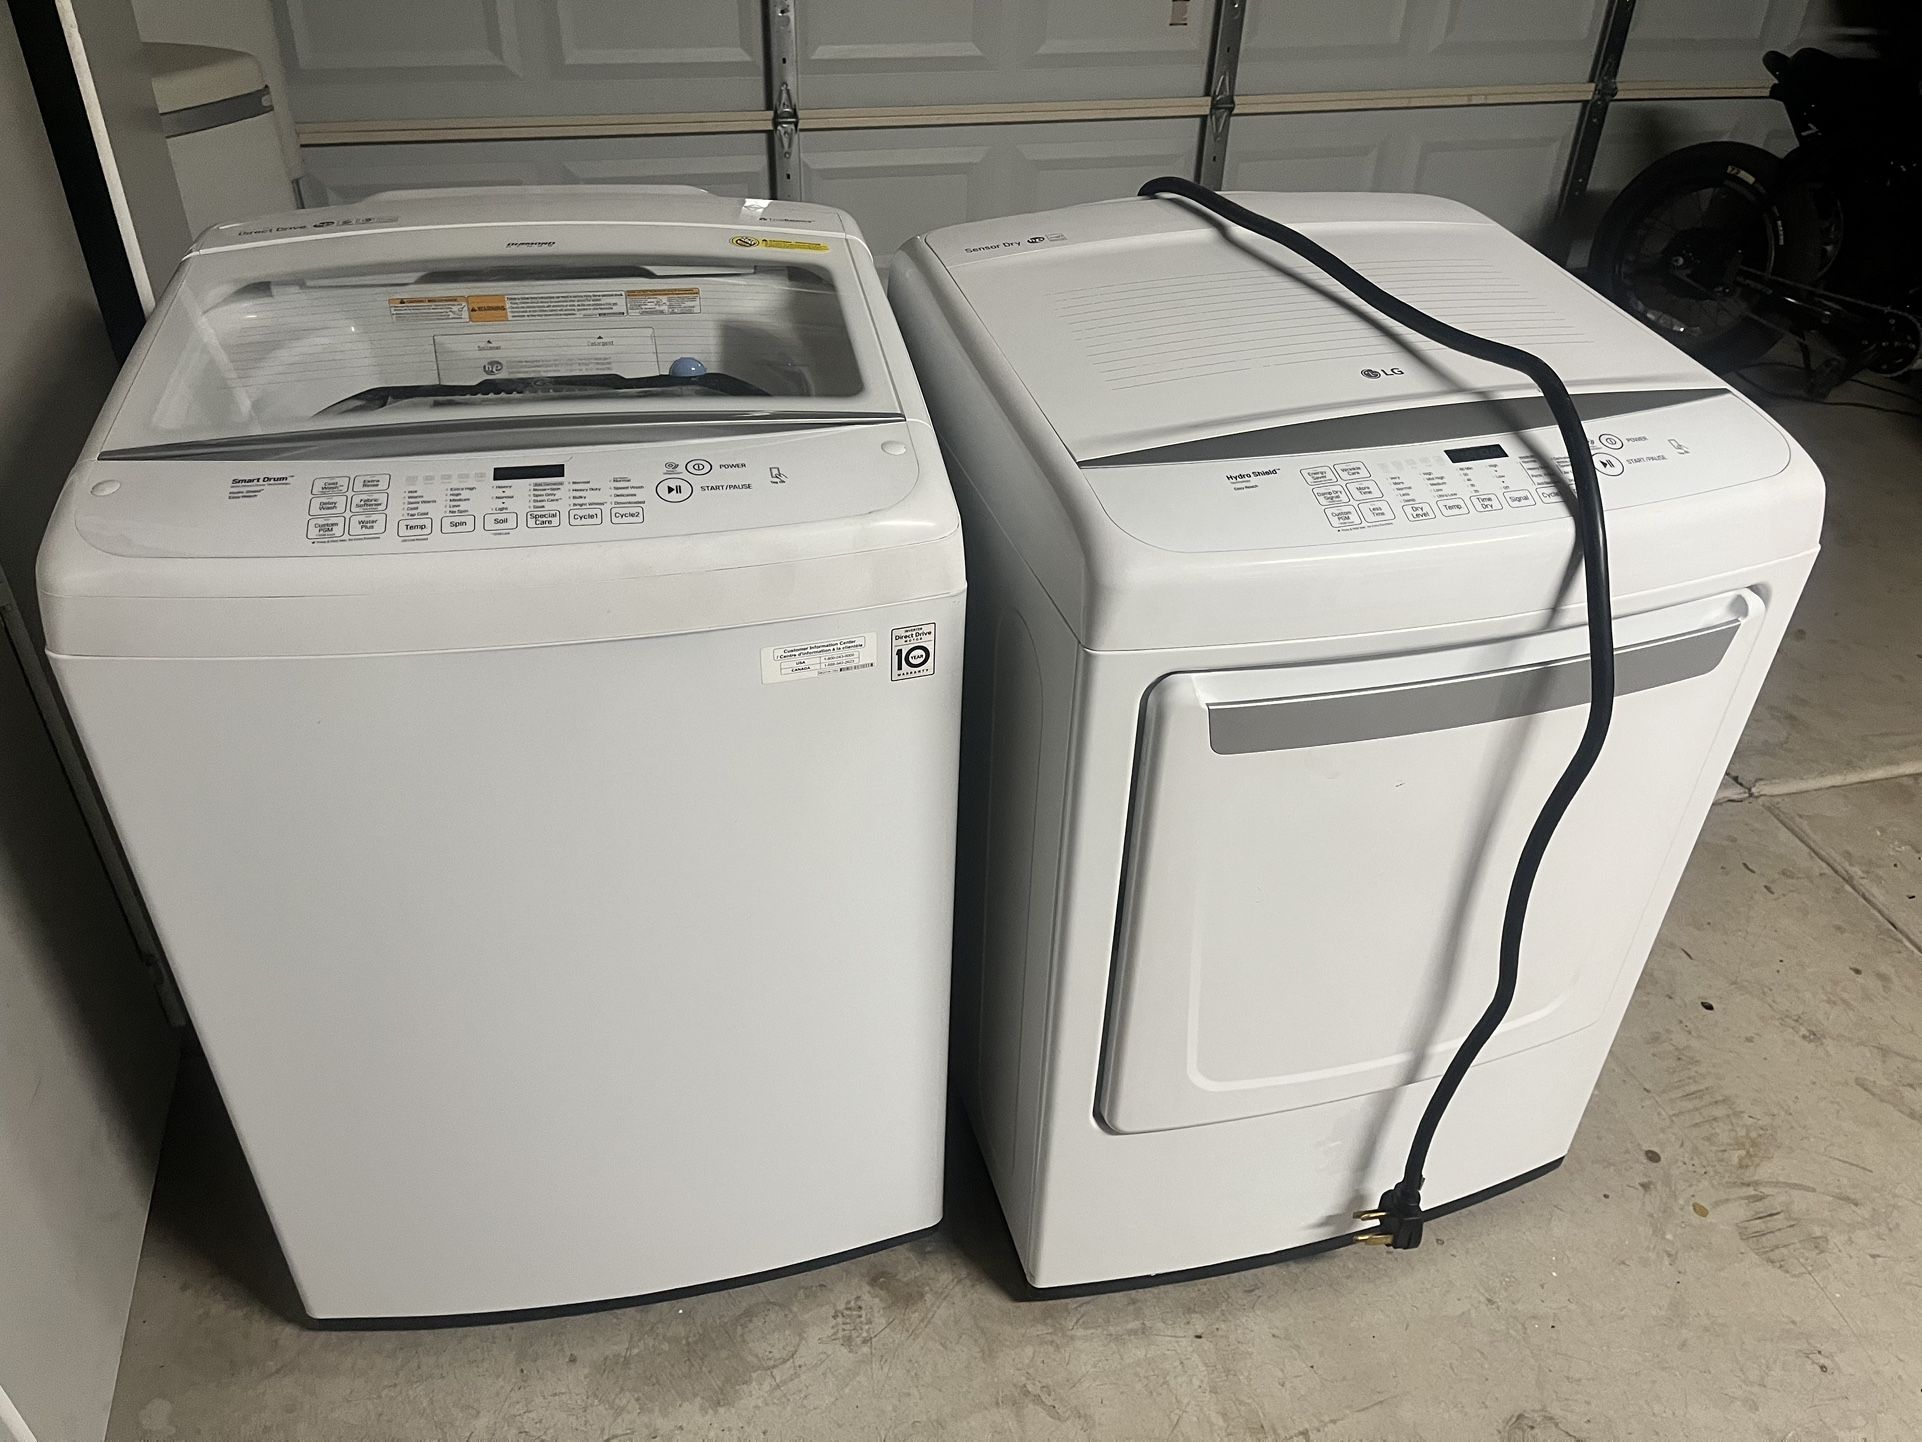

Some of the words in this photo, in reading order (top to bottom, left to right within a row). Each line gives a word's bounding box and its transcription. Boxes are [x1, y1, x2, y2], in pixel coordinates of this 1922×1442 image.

[965, 244, 1000, 254] Sensor
[1380, 368, 1404, 376] LG
[232, 477, 260, 485] Smart
[1226, 473, 1251, 481] Hydro
[701, 483, 752, 491] START/PAUSE
[530, 512, 557, 520] Special
[573, 513, 598, 521] Cycle1
[614, 512, 639, 520] Cycle2
[450, 520, 467, 528] Spin
[798, 648, 831, 656] d'information
[896, 645, 930, 670] 10
[897, 668, 929, 676] WARRANTY
